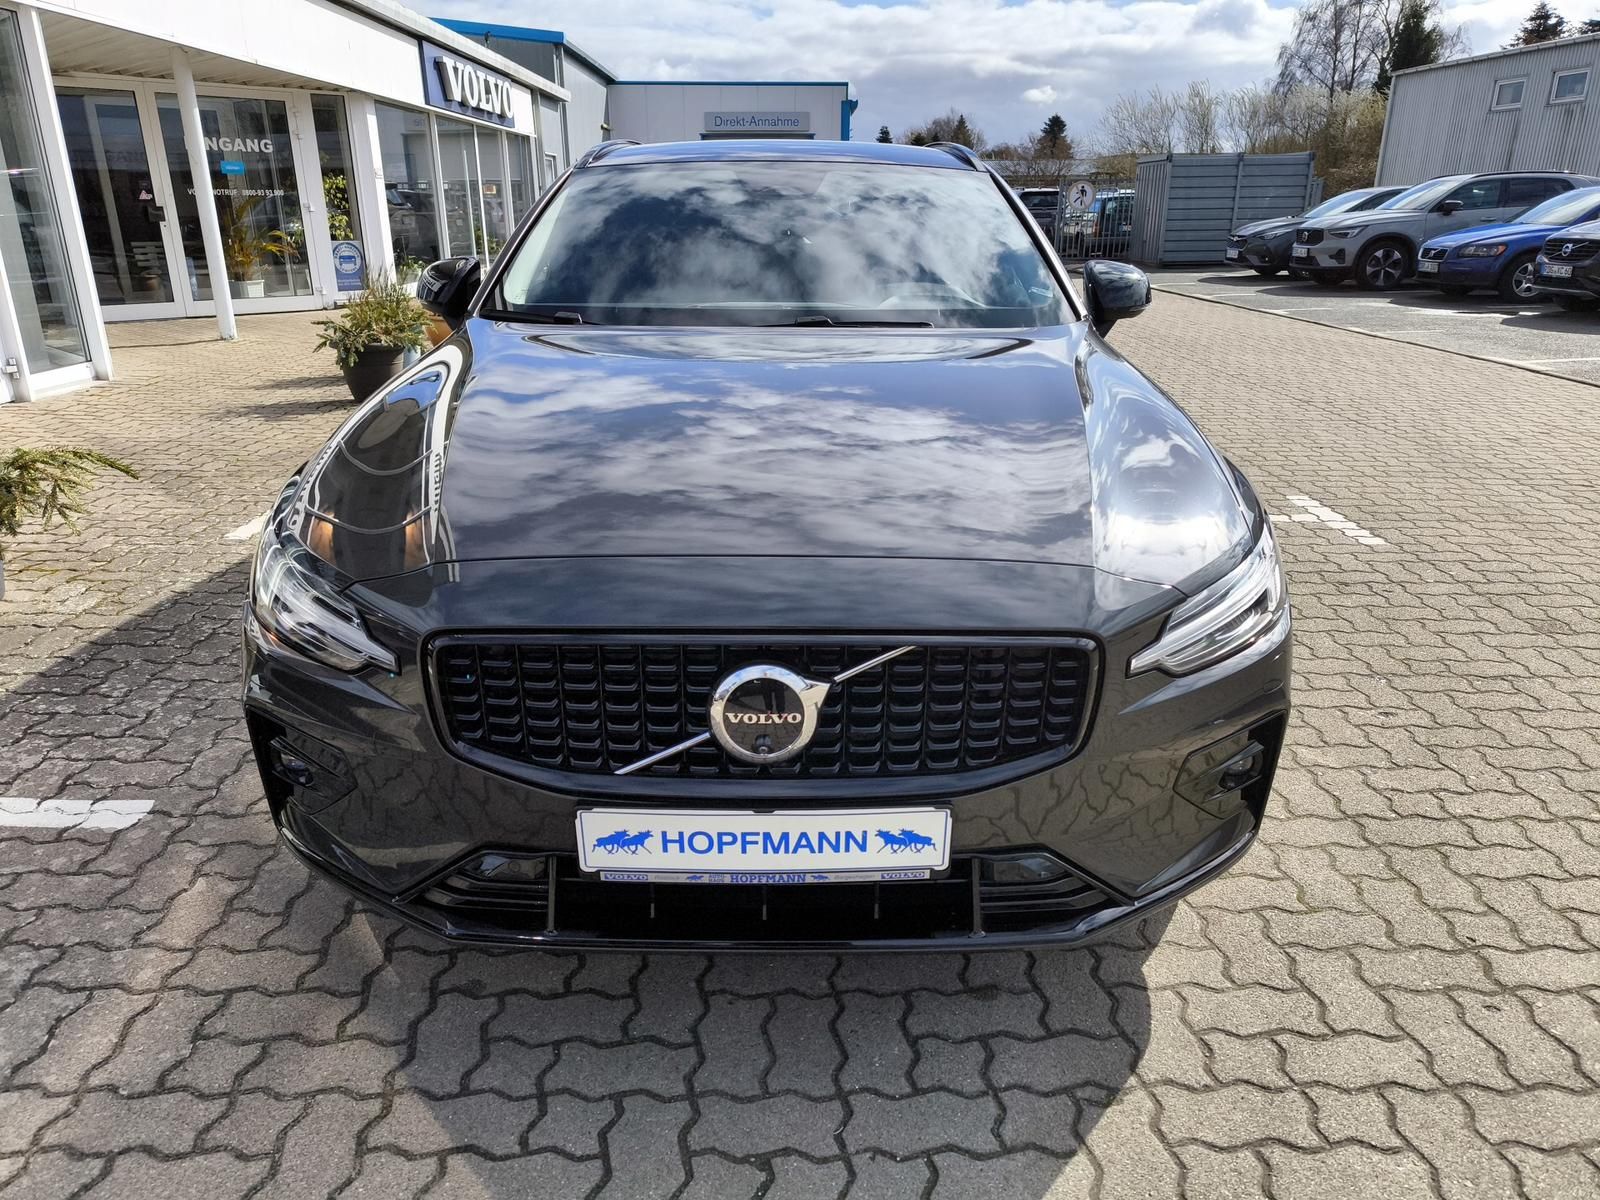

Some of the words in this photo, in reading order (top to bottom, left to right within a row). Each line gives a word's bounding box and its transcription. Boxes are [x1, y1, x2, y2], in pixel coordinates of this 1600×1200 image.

[436, 55, 514, 118] VOLVO
[714, 115, 800, 127] Direkt-Annahme
[184, 136, 274, 153] NGANG
[725, 712, 802, 724] VOLVO
[661, 830, 868, 854] HOPFMANN
[730, 873, 807, 883] HOPFMANN
